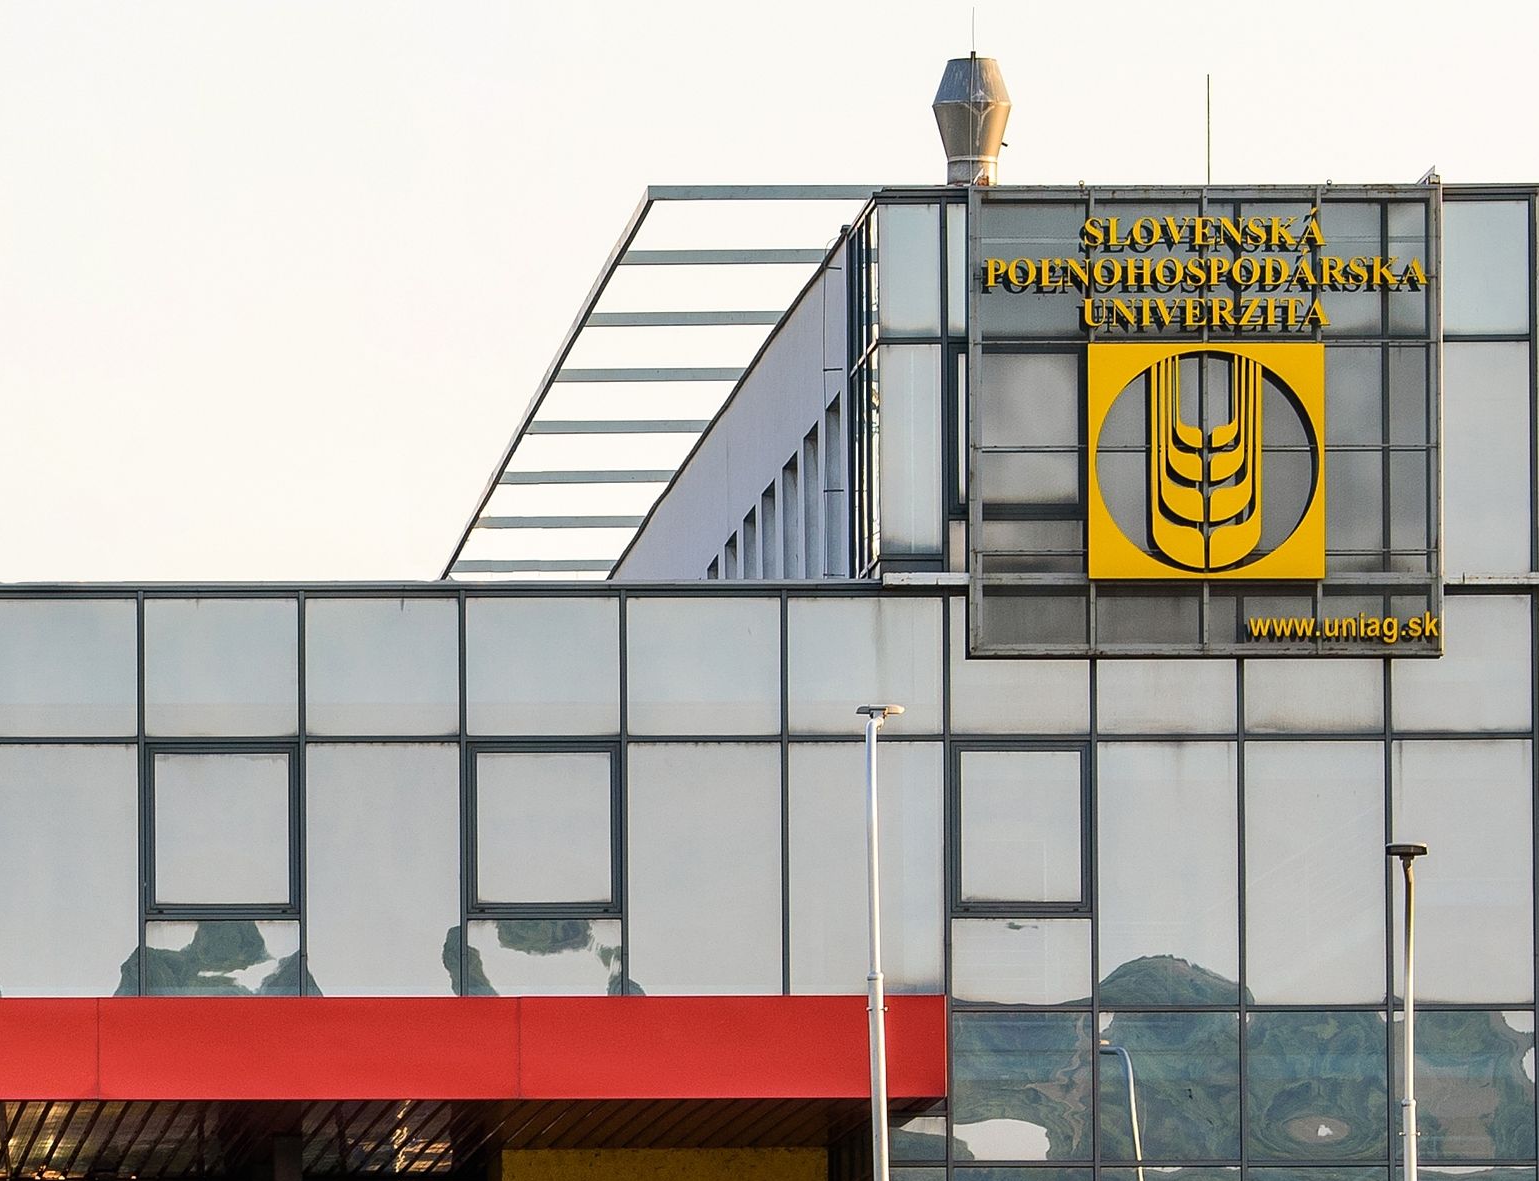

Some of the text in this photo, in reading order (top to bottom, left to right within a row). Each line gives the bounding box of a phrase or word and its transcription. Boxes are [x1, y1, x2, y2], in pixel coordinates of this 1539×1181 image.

[1082, 207, 1328, 248] SLOVENSKÁ
[984, 249, 1429, 289] POĽNOHOSPODÁRSKA
[1082, 297, 1331, 328] UNIVERZITA
[1249, 611, 1439, 644] www.uniag.sk
